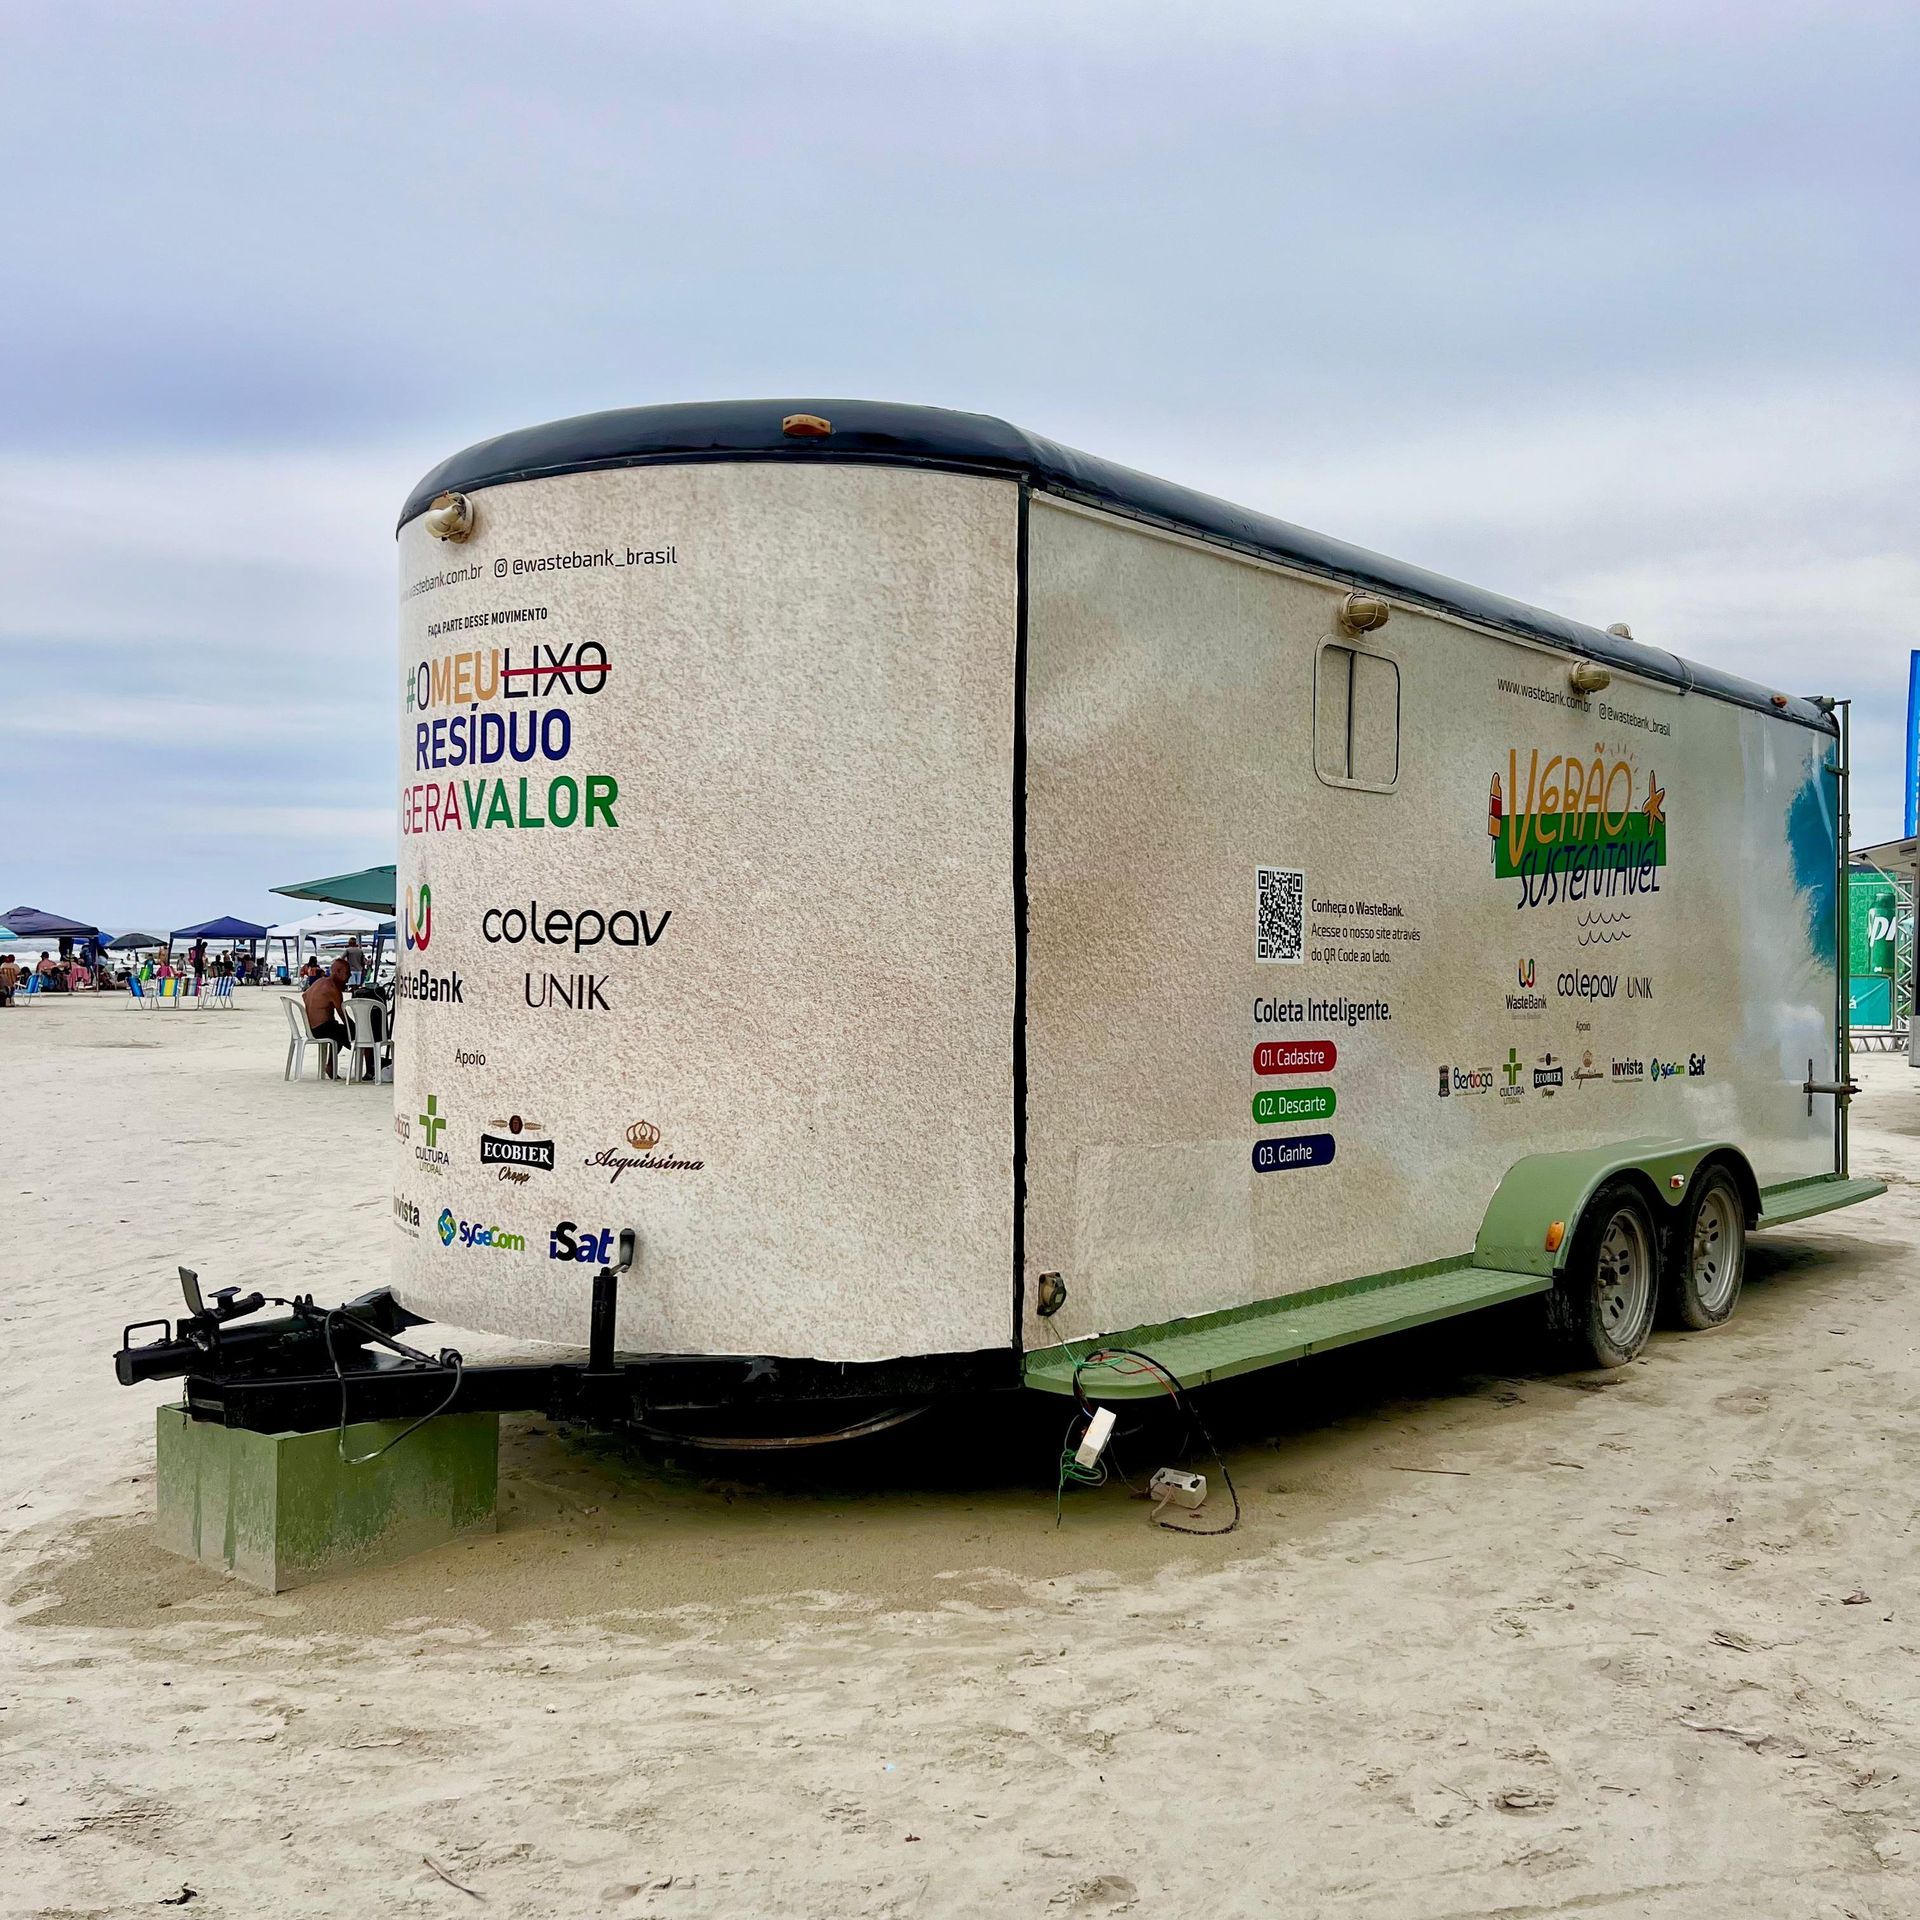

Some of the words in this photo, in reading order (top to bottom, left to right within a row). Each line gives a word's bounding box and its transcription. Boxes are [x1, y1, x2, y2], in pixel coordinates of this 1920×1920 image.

[512, 547, 678, 576] @wastebank_brasil
[427, 623, 442, 638] FAÇA
[442, 617, 463, 634] PARTE
[464, 613, 490, 629] DESSE
[491, 607, 548, 625] MOVIMENTO
[1497, 678, 1592, 713] www.wastebank.com.br
[1607, 706, 1672, 737] @wastebank_brasil
[416, 702, 572, 771] RESÍDUO
[1311, 898, 1348, 918] Conheça
[1348, 903, 1355, 915] o
[1356, 901, 1405, 918] WasteBank.
[482, 900, 673, 954] colepav
[1311, 923, 1341, 938] Acesse
[1342, 927, 1348, 938] o
[1350, 928, 1375, 939] nosso
[1376, 926, 1391, 940] site
[1392, 927, 1421, 941] através
[1311, 948, 1322, 961] do
[1323, 947, 1336, 965] QR
[1337, 948, 1359, 963] Code
[1360, 951, 1371, 963] ao
[1372, 949, 1391, 963] lado.
[525, 973, 611, 1010] UNIK
[1557, 968, 1618, 1003] colepav
[1627, 976, 1653, 999] UNIK
[1254, 997, 1304, 1023] Coleta
[1307, 997, 1392, 1027] Inteligente.
[1505, 994, 1547, 1010] WasteBank
[455, 1048, 487, 1067] Apoio
[1260, 1049, 1275, 1067] 01.
[1277, 1048, 1325, 1066] Cadastre
[1453, 1066, 1493, 1095] Bertioga
[1499, 1086, 1525, 1098] CULTURA
[1259, 1098, 1276, 1116] 02.
[1278, 1096, 1326, 1114] Descarte
[415, 1146, 450, 1166] CULTURA
[483, 1140, 553, 1166] ECOBIER
[584, 1146, 705, 1184] Acquissima
[1259, 1146, 1276, 1165] 03.
[1278, 1144, 1313, 1163] Ganhe
[420, 1161, 444, 1176] LITORAL
[497, 1165, 531, 1185] Chopp
[459, 1219, 526, 1252] SyGeCom
[549, 1220, 615, 1265] iSat
